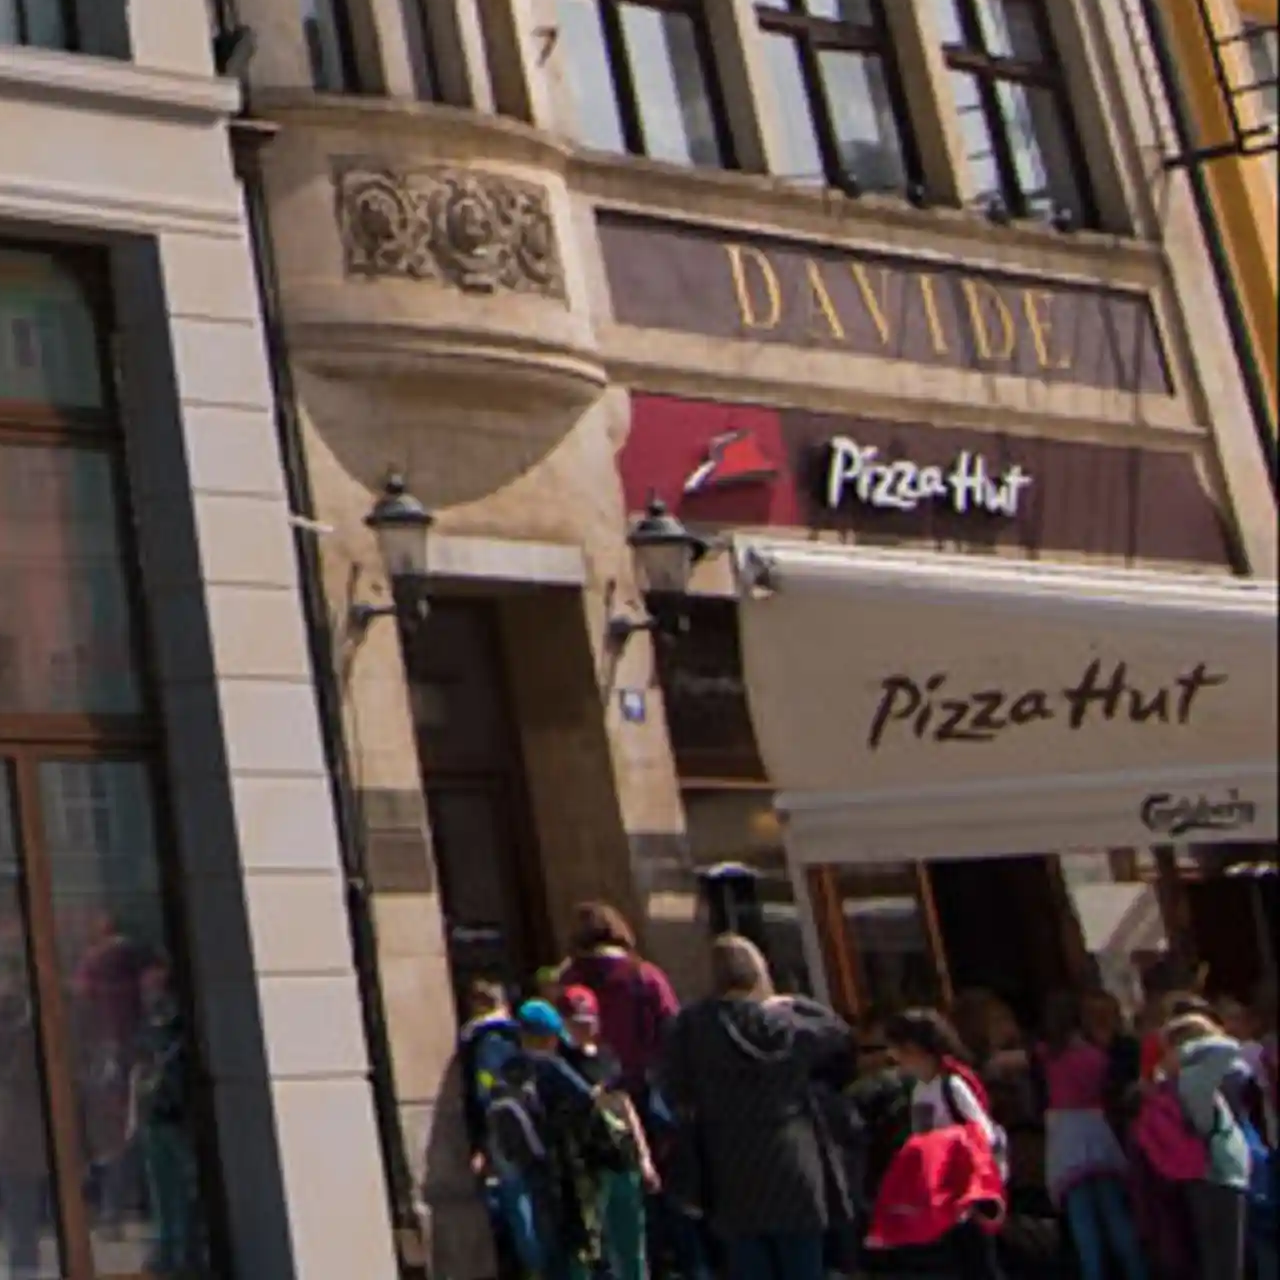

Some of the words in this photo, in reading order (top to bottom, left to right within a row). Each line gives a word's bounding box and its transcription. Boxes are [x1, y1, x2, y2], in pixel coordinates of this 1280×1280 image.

[724, 243, 1074, 369] DAVIDE
[828, 436, 947, 509] Pizza
[947, 450, 1034, 516] Hut
[867, 671, 1055, 750] Pizza
[1063, 657, 1230, 730] Hut
